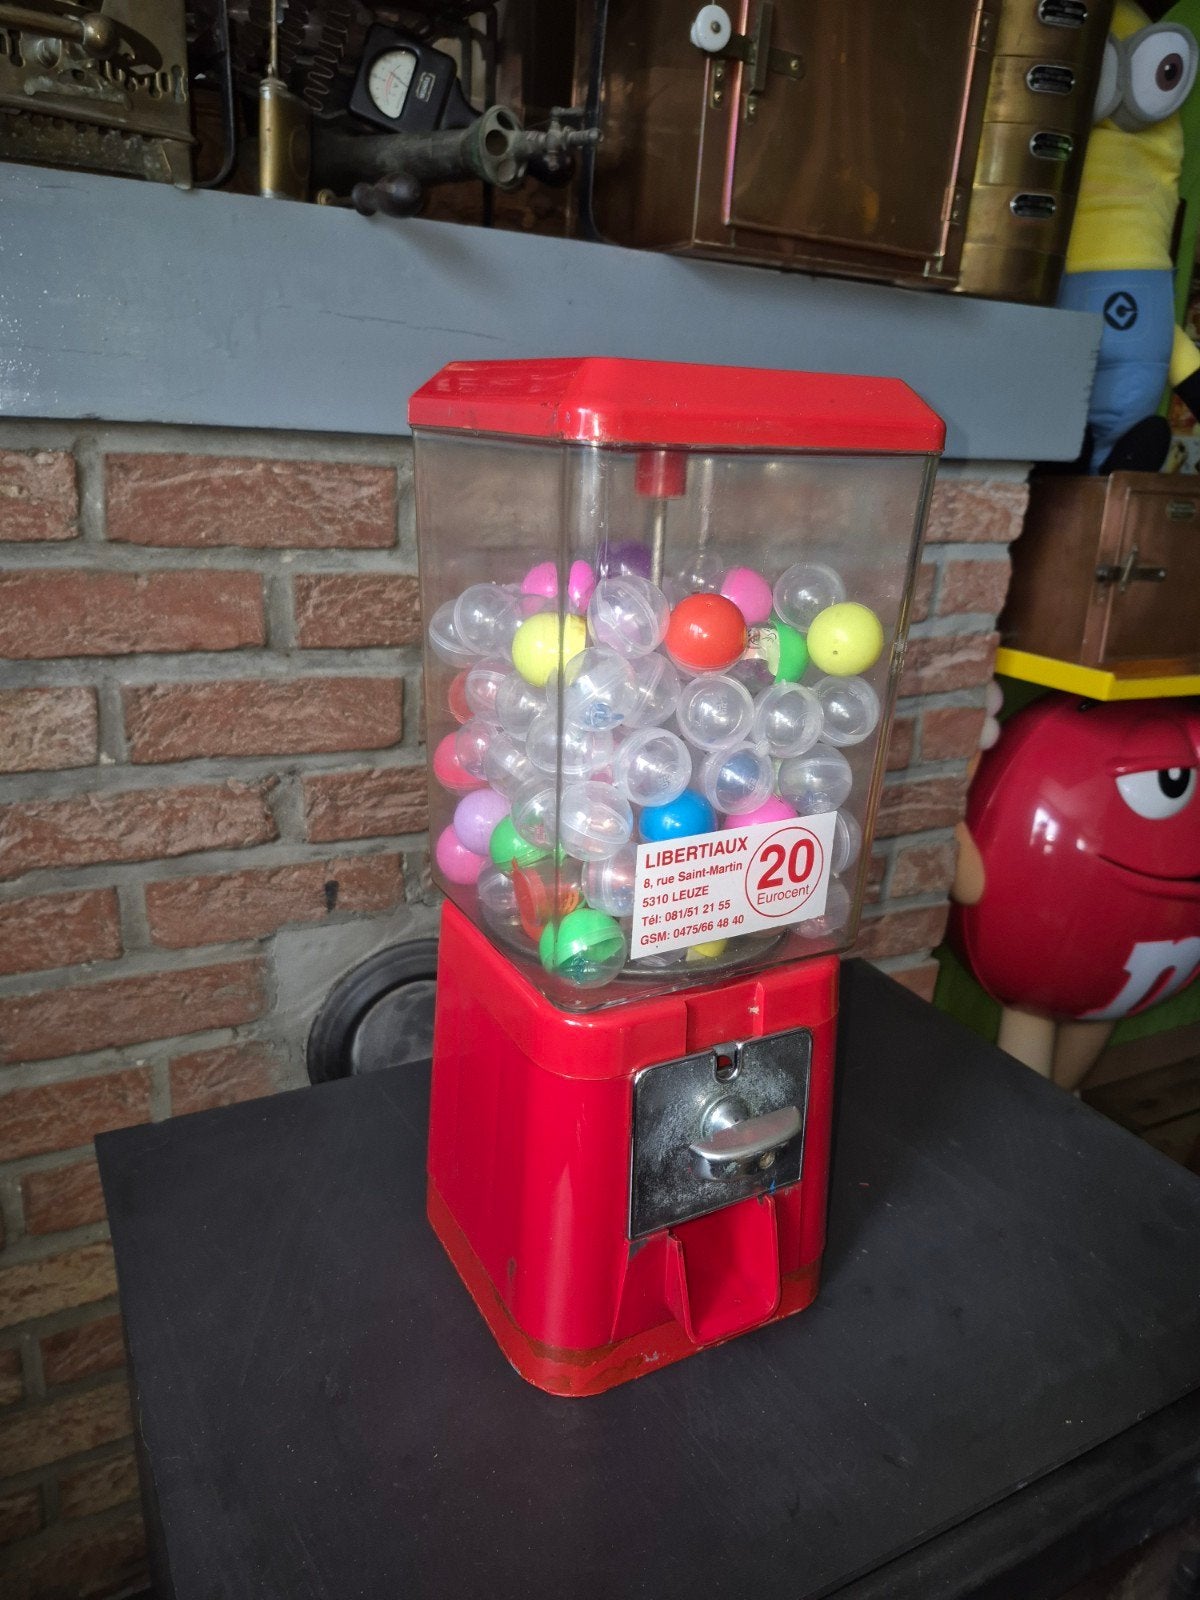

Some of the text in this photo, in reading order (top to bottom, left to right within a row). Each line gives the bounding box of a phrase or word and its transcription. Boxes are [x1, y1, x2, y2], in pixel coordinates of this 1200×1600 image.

[645, 836, 749, 869] LIBERTIAUX
[757, 838, 814, 890] 20
[644, 862, 742, 890] 8, rue Saint-Martin
[642, 886, 709, 908] 5310 LEUZE
[757, 884, 810, 905] Eurocent
[641, 900, 731, 927] Tél: 081/51 21 55
[640, 915, 744, 946] GSM: 0475/66 48 40
